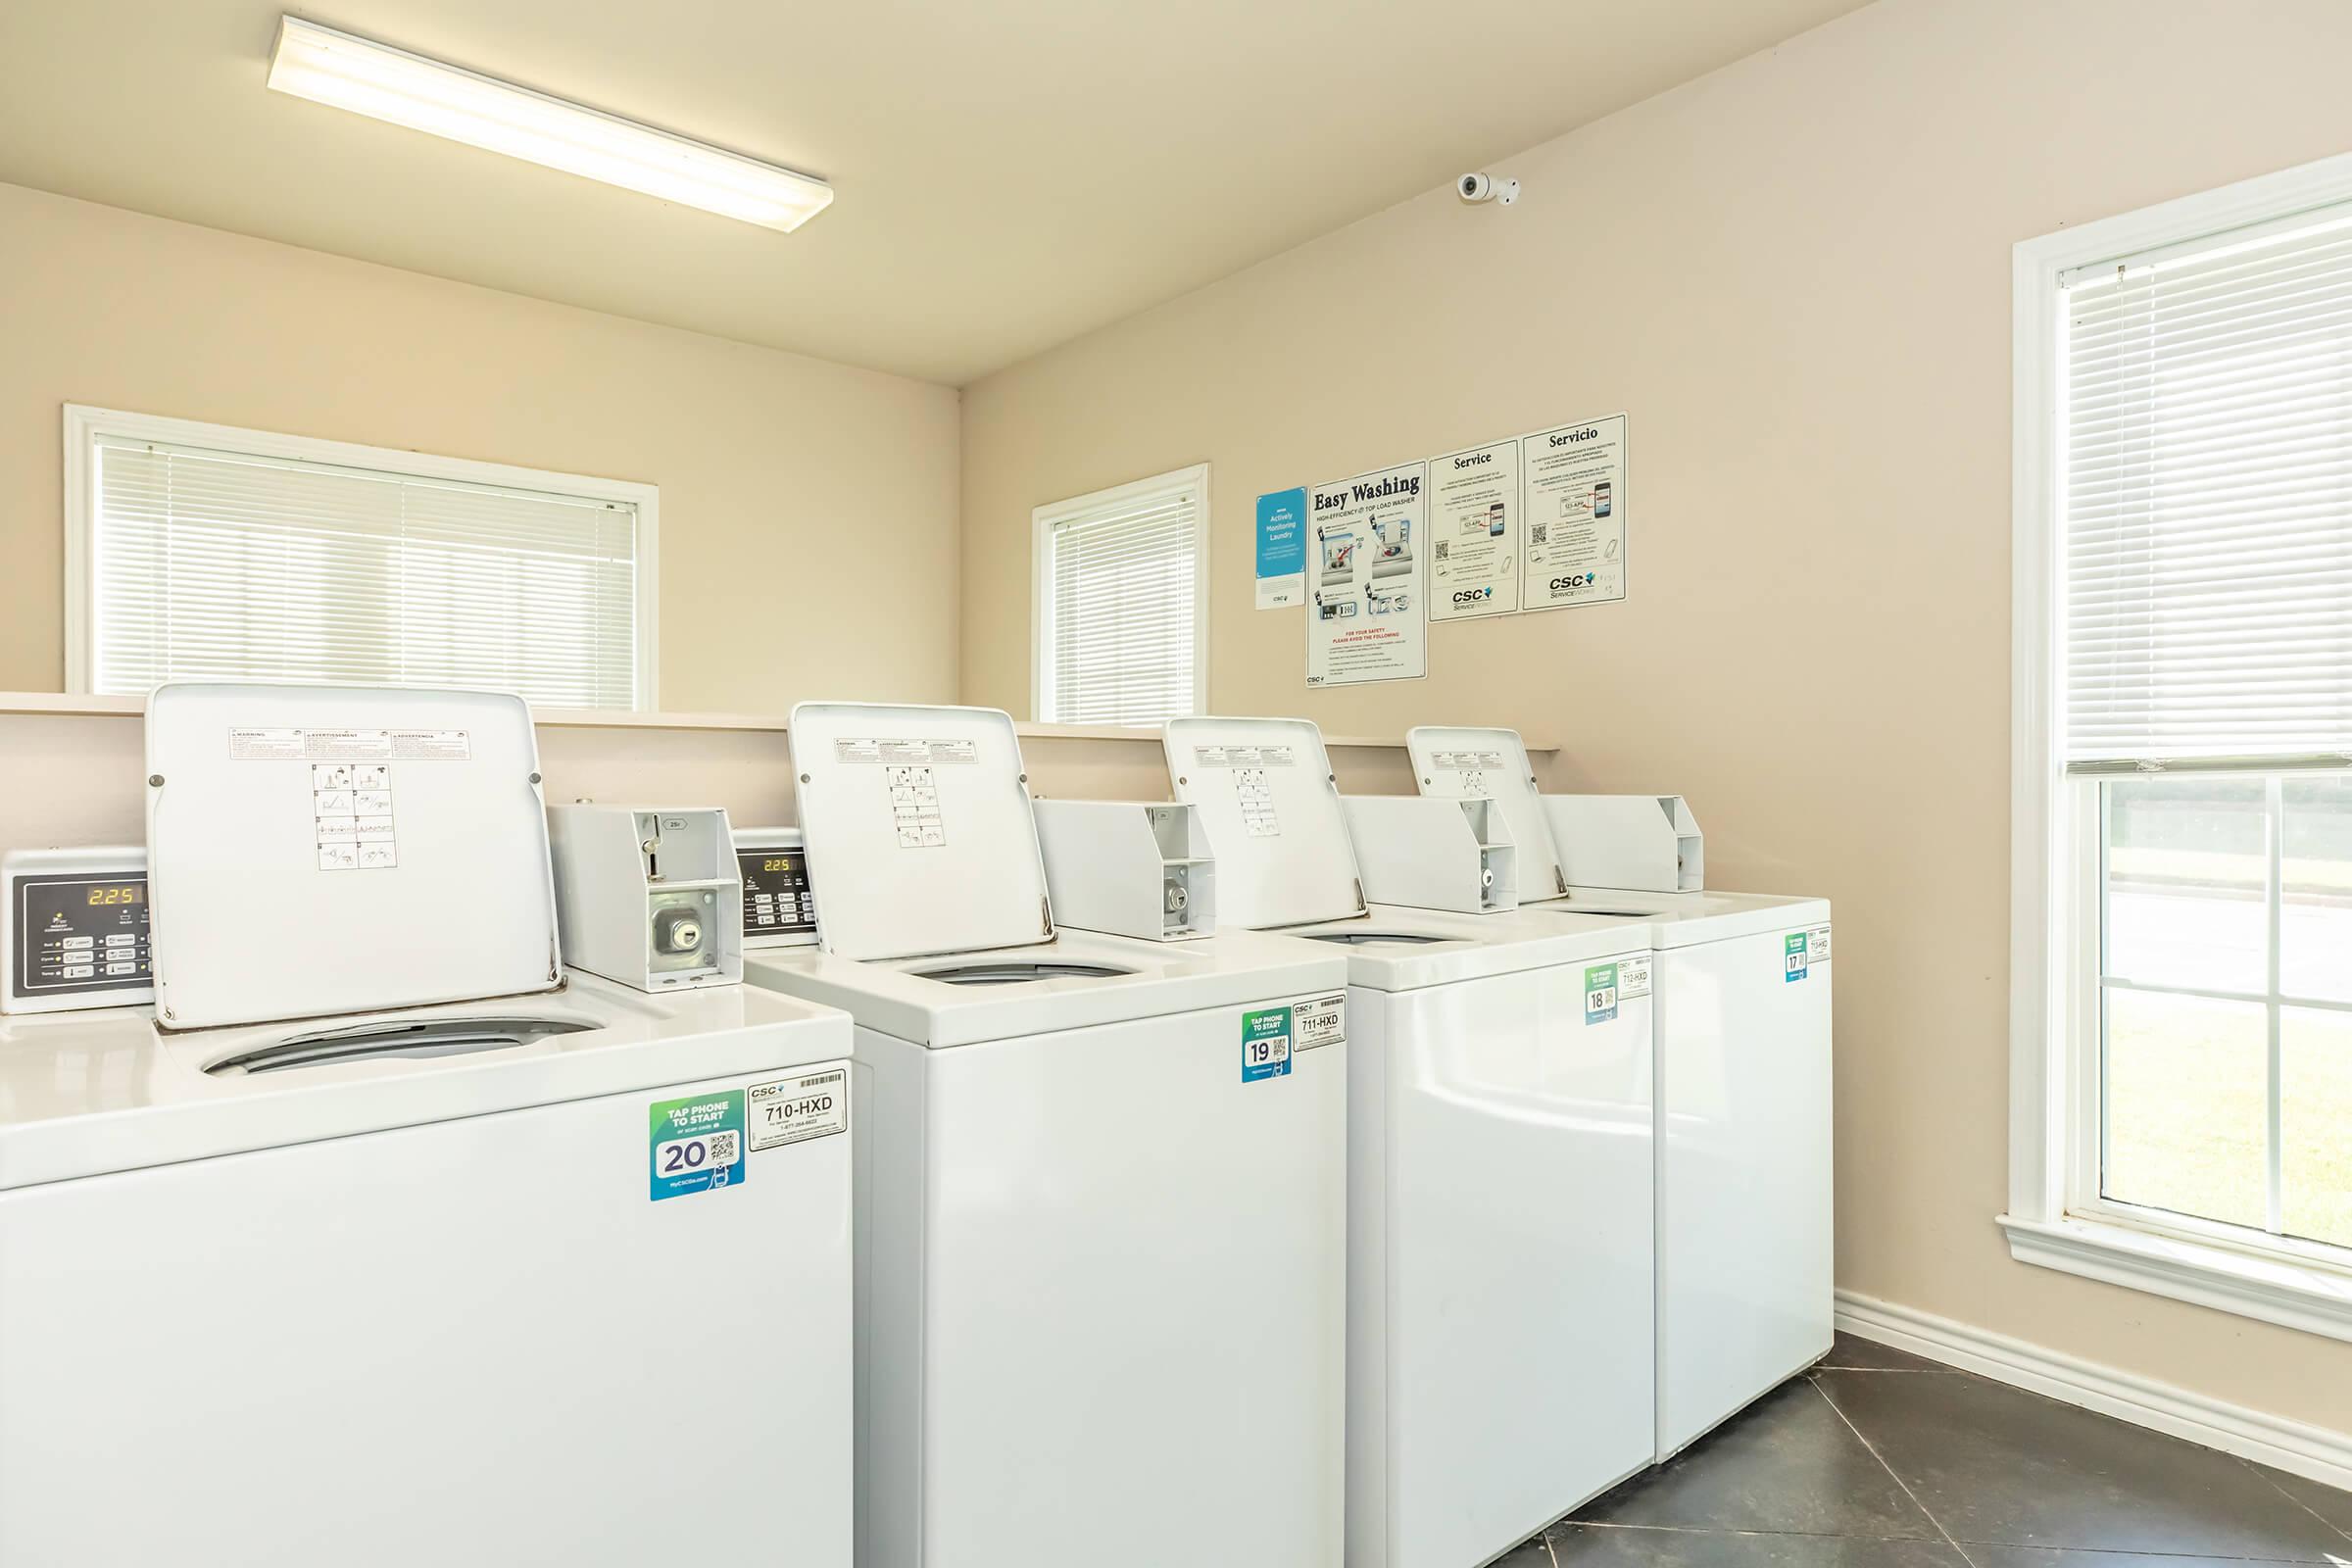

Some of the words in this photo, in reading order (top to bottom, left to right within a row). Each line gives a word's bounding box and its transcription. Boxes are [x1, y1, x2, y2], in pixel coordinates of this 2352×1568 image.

[1549, 427, 1598, 448] Servicio
[1454, 453, 1492, 470] Service
[1314, 492, 1348, 511] Easy
[1351, 476, 1420, 503] Washing
[1316, 509, 1357, 521] HIGH-EFFICIENCY
[1365, 504, 1376, 513] TOP
[1377, 500, 1392, 511] LOAD
[1392, 496, 1416, 507] WASHER
[1270, 513, 1293, 522] Actively
[1266, 521, 1296, 532] Monitoring
[1270, 531, 1293, 541] Laundry
[1549, 575, 1584, 590] CSC
[1452, 589, 1483, 603] CSC
[89, 888, 133, 906] 2.25
[1789, 956, 1797, 969] 17
[1295, 1004, 1308, 1013] CSC
[1592, 993, 1603, 1009] 18
[1262, 1021, 1281, 1030] START
[1263, 1013, 1284, 1023] PHONE
[1302, 1014, 1338, 1031] 711-HXD
[1250, 1042, 1269, 1062] 19
[752, 1087, 776, 1098] CSC
[667, 1108, 689, 1119] TAP
[691, 1101, 729, 1115] PHONE
[765, 1097, 832, 1122] 710-HXD
[672, 1117, 688, 1128] TO
[690, 1111, 725, 1124] START
[664, 1141, 706, 1172] 20
